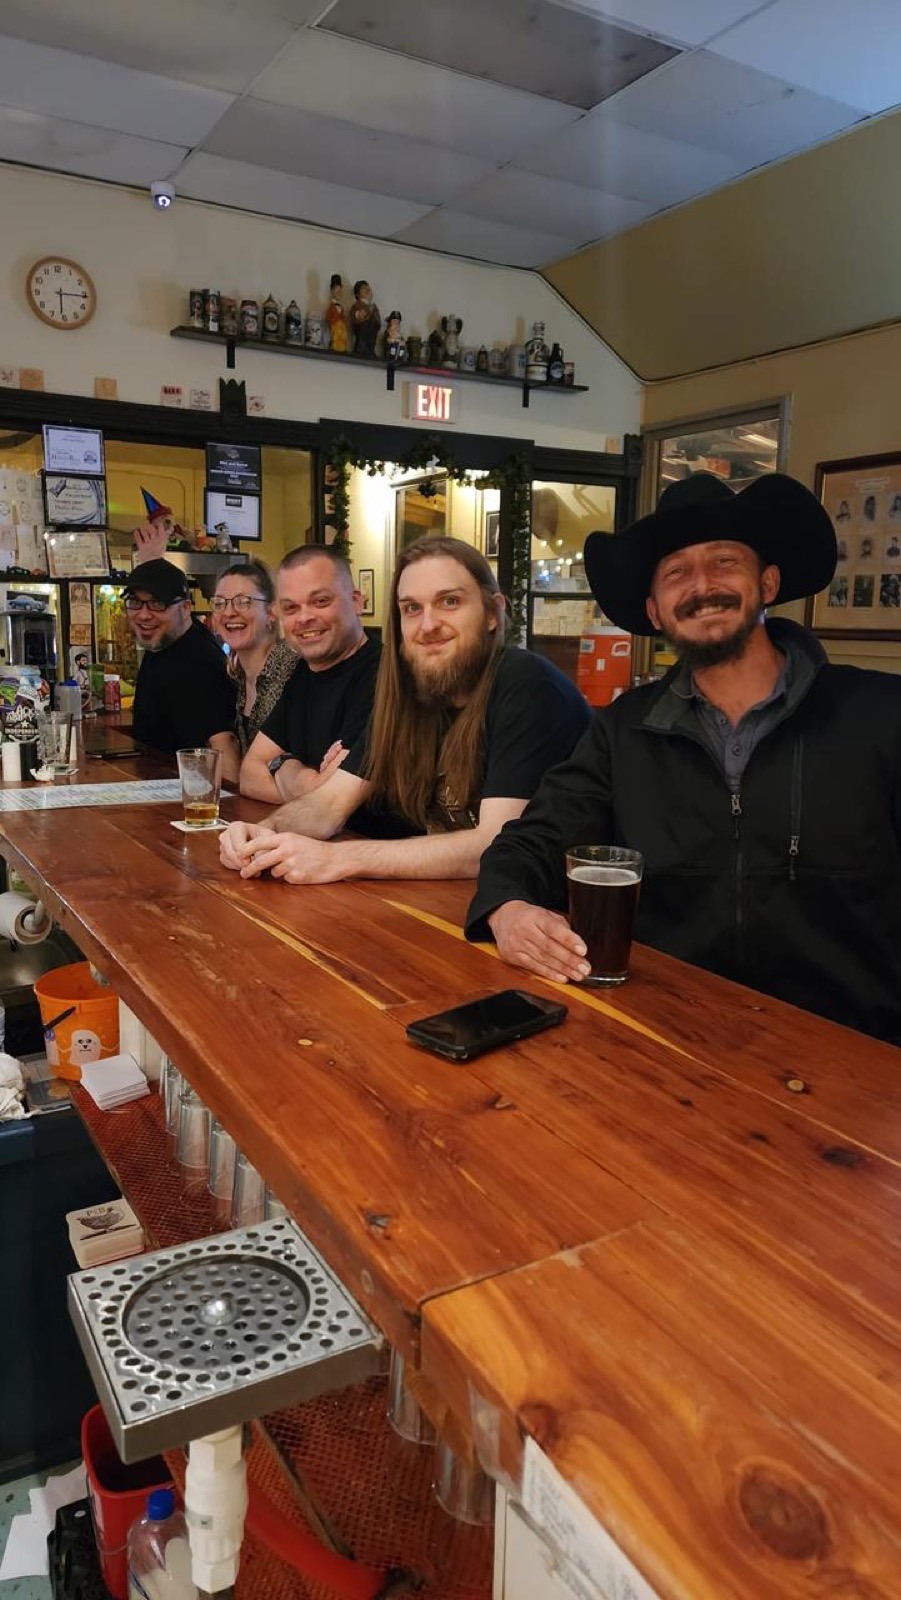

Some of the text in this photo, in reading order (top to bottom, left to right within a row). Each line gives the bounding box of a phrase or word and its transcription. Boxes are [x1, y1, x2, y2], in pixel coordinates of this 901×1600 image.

[54, 265, 62, 273] 12
[35, 276, 43, 285] 10
[34, 288, 40, 296] 9
[40, 300, 46, 309] 8
[50, 310, 56, 318] 7
[73, 311, 79, 320] 5
[418, 384, 452, 420] EXIT
